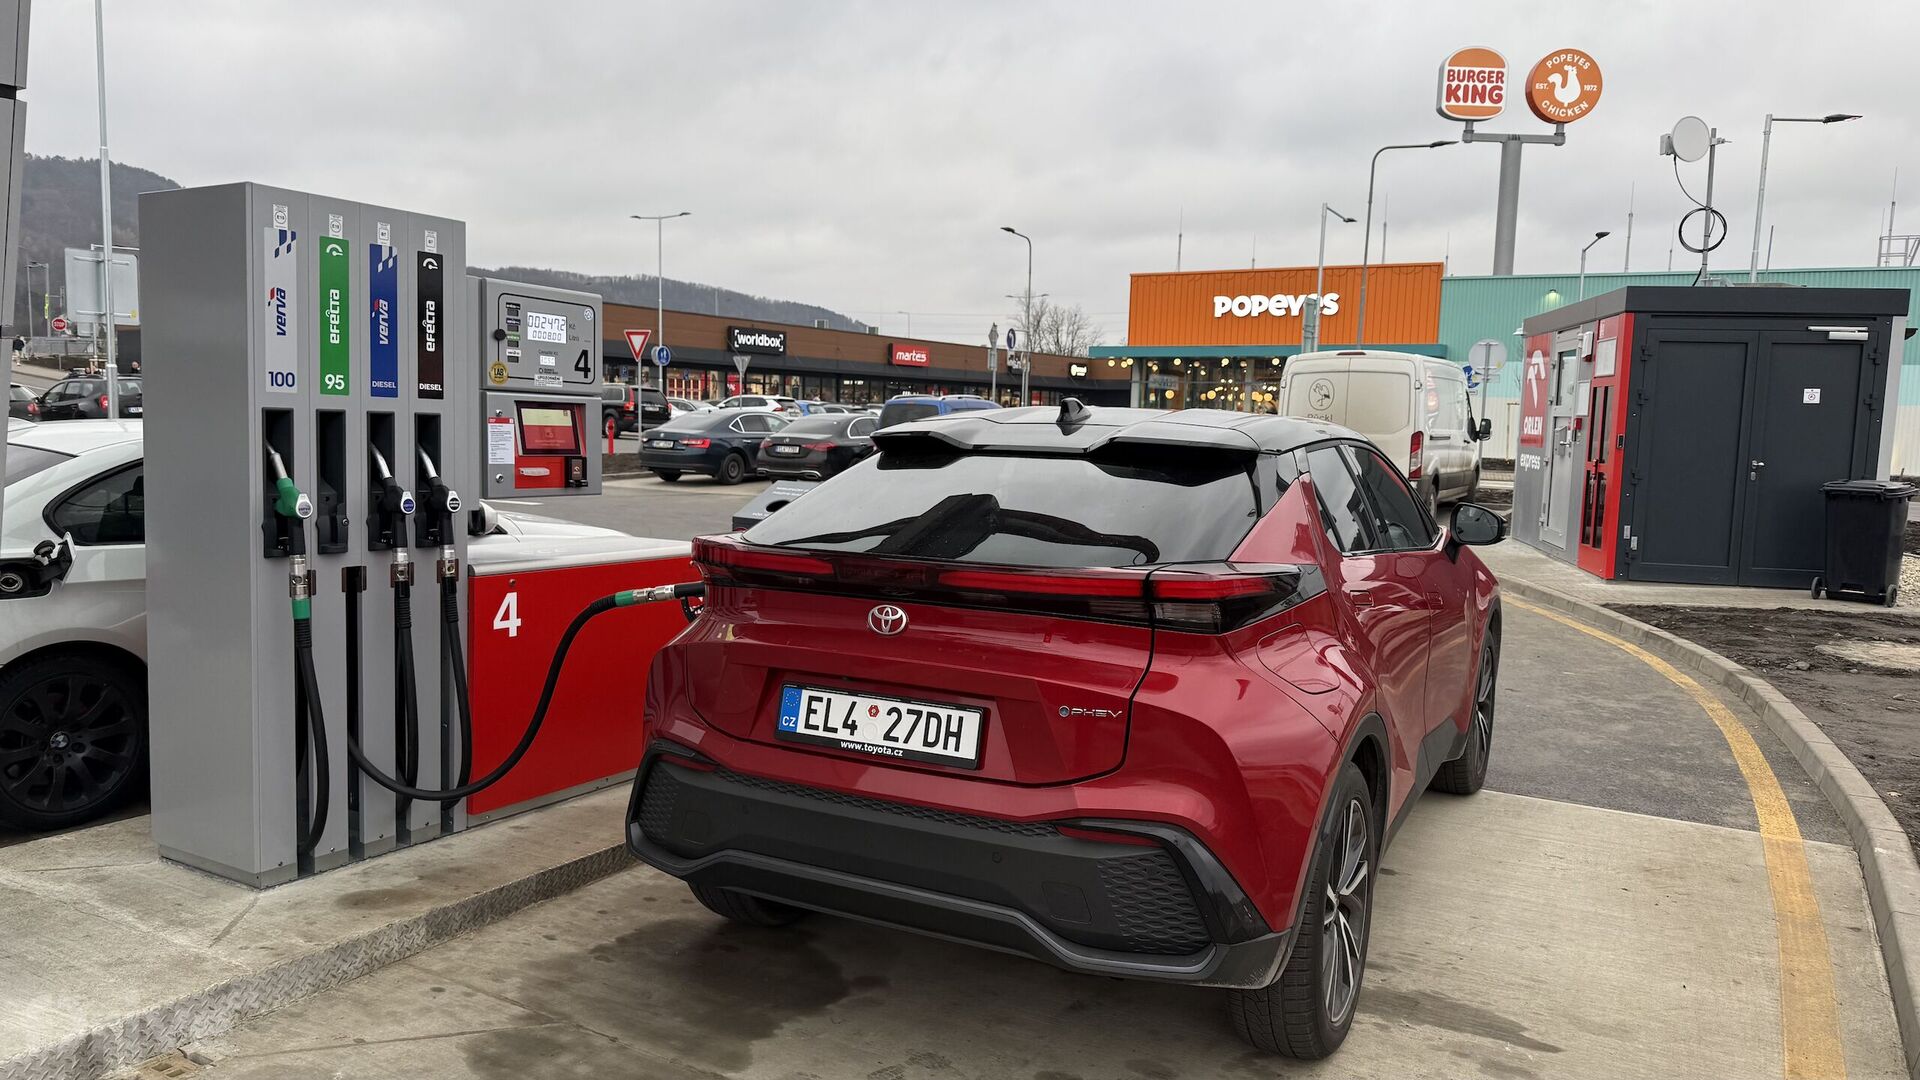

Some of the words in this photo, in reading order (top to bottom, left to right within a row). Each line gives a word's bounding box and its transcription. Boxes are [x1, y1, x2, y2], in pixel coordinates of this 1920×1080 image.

[1545, 53, 1591, 70] POPEYES
[1446, 68, 1505, 85] BURGER
[1445, 84, 1504, 104] KING
[1535, 82, 1549, 90] EST.
[1541, 99, 1589, 117] CHICKEN
[276, 287, 287, 336] verva
[327, 289, 340, 344] efecta
[378, 298, 389, 345] verva
[423, 300, 436, 352] efecta
[736, 331, 783, 350] worldbox
[574, 349, 591, 379] 4
[895, 349, 927, 363] martes
[268, 371, 296, 388] 100
[324, 373, 345, 390] 95
[372, 380, 397, 389] DIESEL
[419, 382, 443, 391] DIESEL
[1523, 416, 1543, 435] ORLEN
[1520, 453, 1541, 471] express
[493, 591, 522, 638] 4
[782, 716, 796, 727] CZ
[1071, 707, 1123, 718] PHEV
[804, 695, 858, 736] EL4
[882, 706, 964, 752] 27DH
[840, 739, 904, 757] www.toyota.cz
